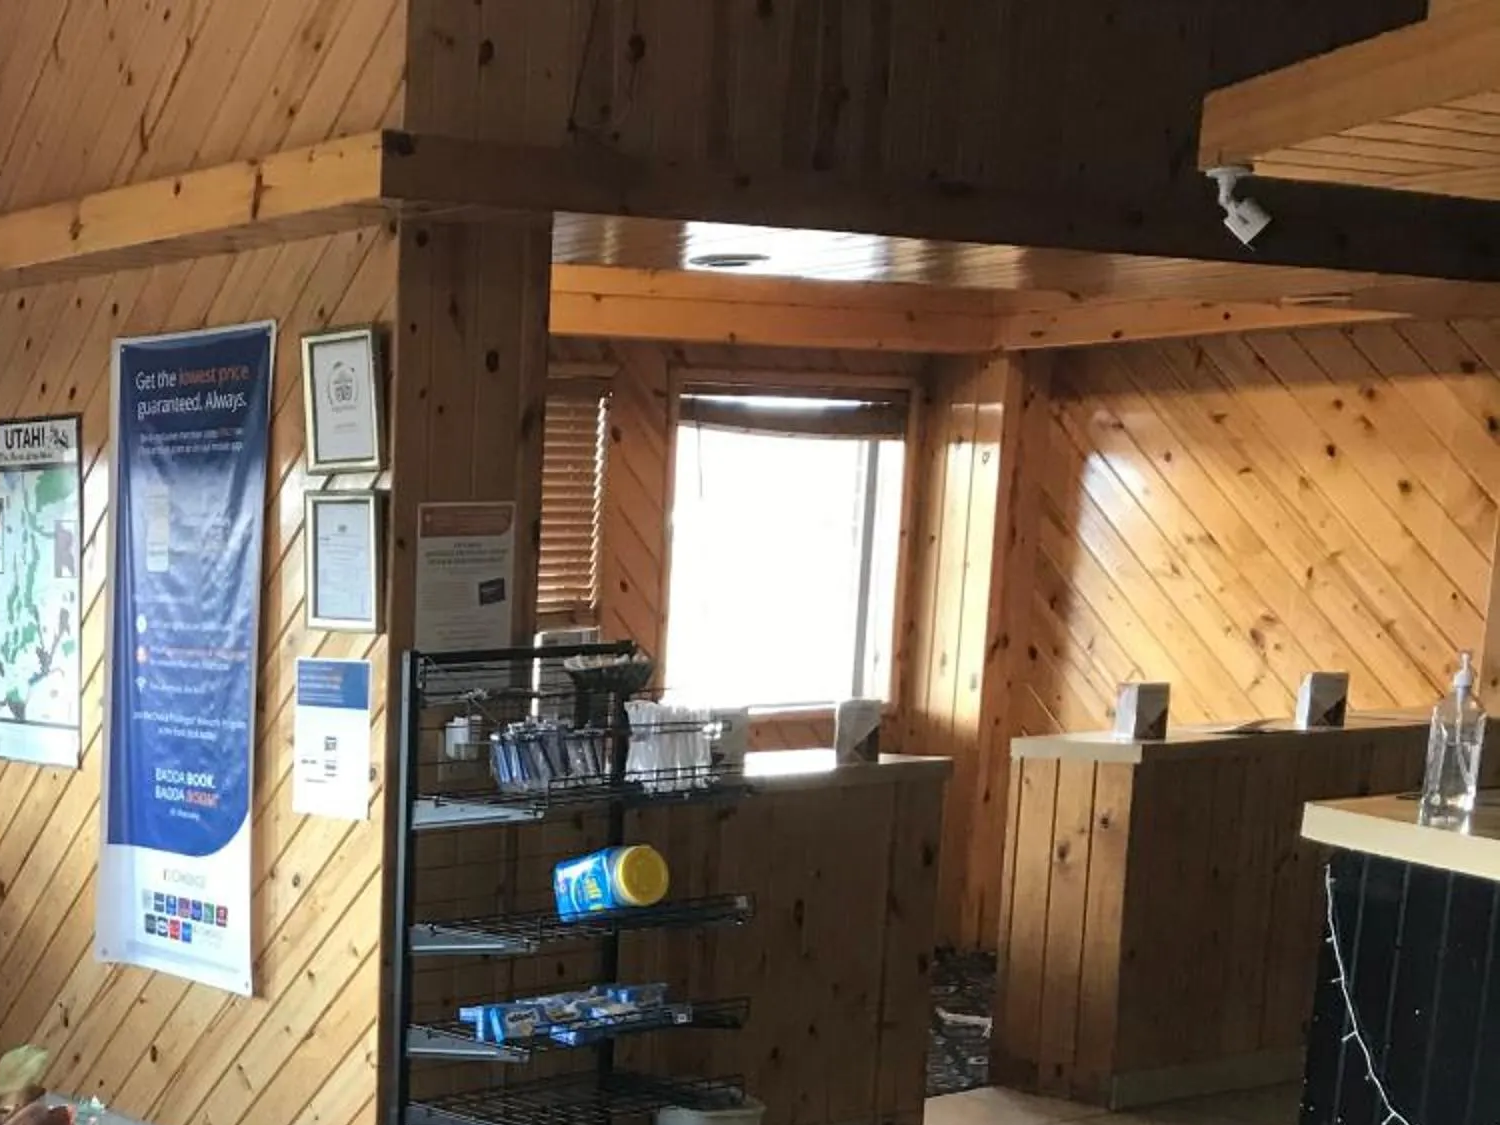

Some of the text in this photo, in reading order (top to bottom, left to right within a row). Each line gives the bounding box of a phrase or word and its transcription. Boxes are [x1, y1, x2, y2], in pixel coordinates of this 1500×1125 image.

[135, 365, 250, 390] Get the lowest price
[137, 390, 247, 420] guaranteed. Always.
